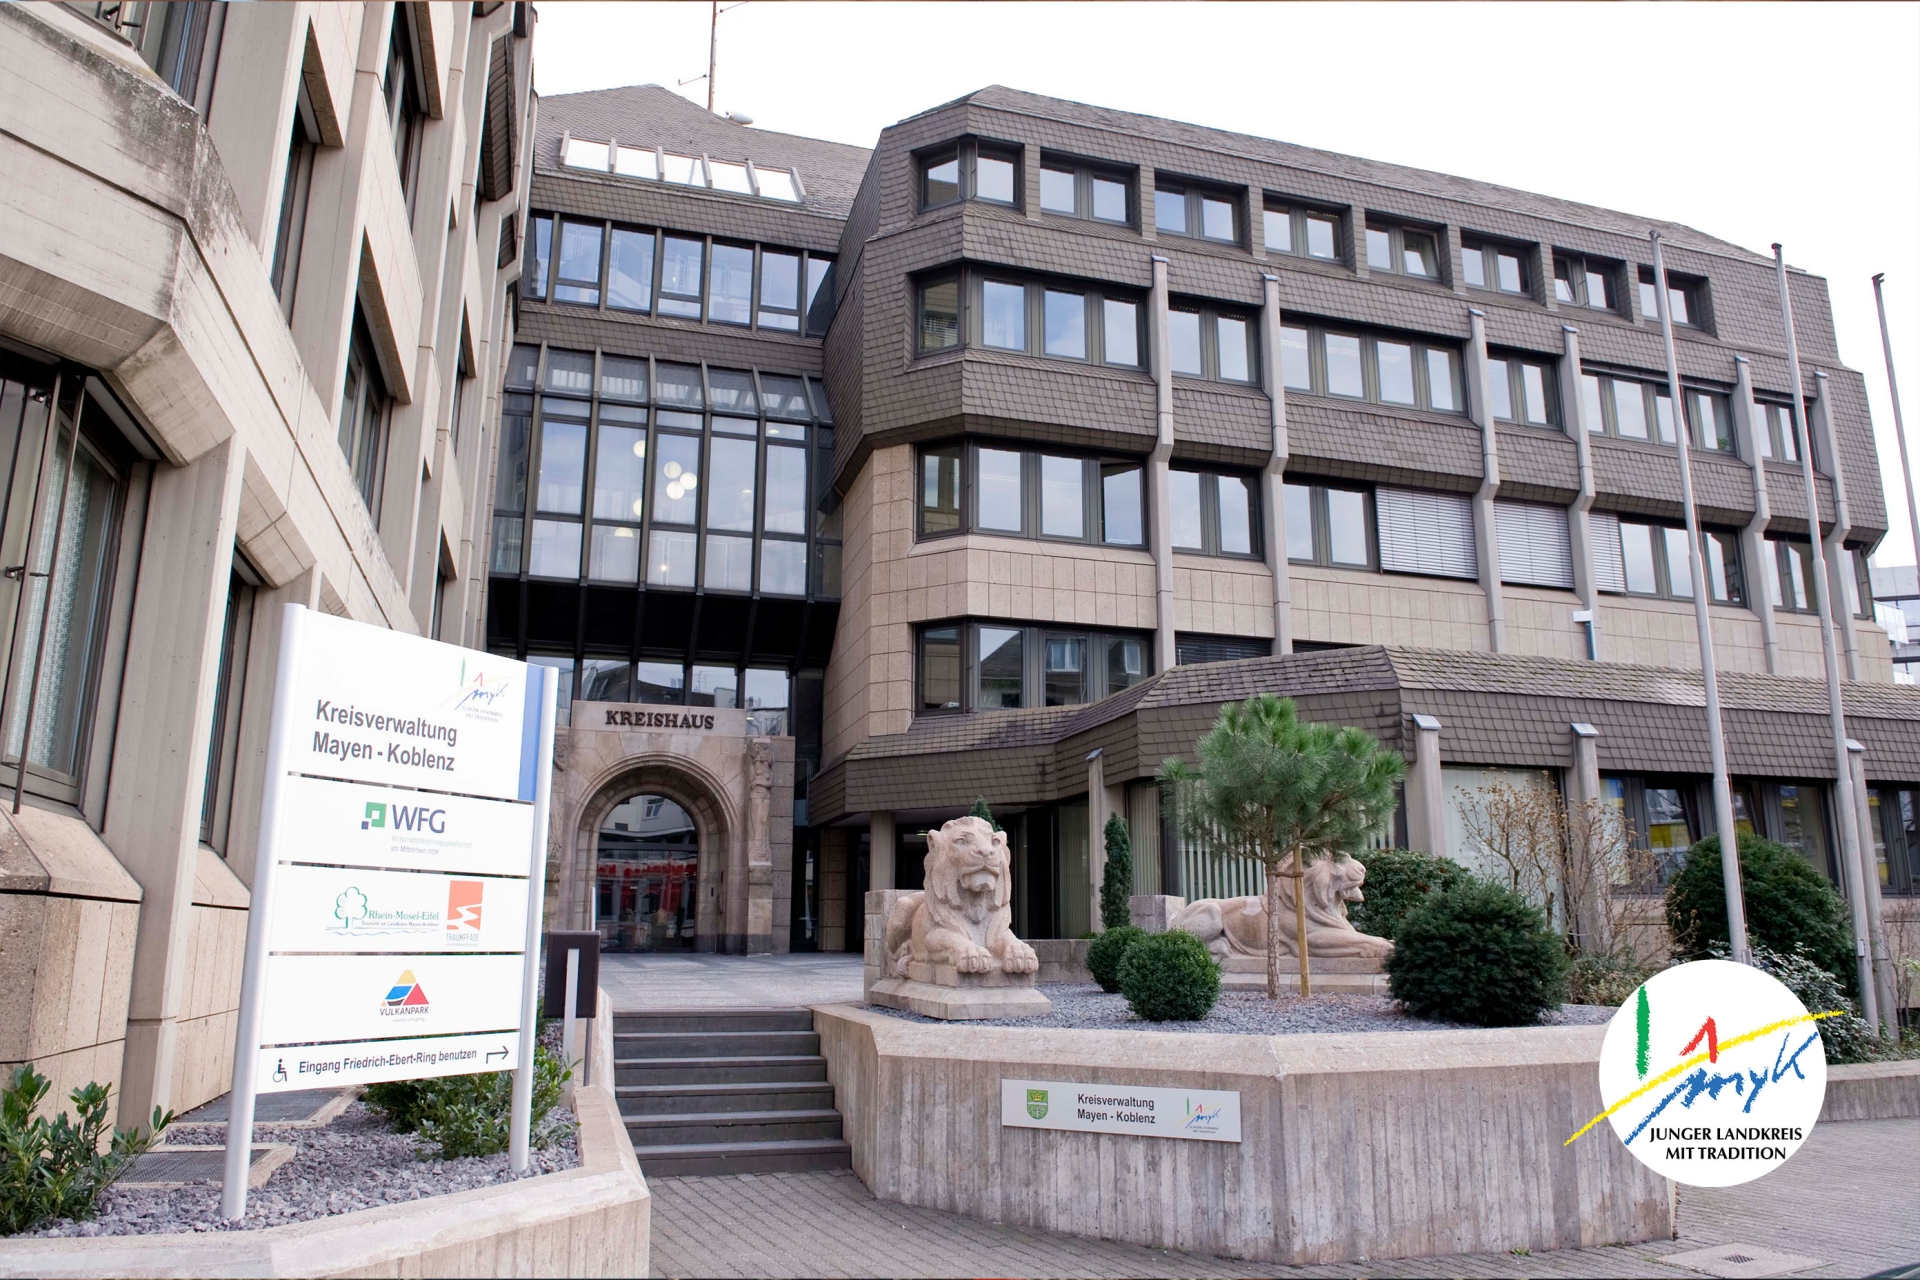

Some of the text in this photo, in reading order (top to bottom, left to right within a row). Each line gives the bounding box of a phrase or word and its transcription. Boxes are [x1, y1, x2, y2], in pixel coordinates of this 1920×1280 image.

[316, 699, 458, 746] Kreisverwaltung
[605, 710, 715, 729] KREISHAUS
[313, 731, 373, 761] Mayen
[387, 742, 455, 772] Koblenz
[392, 804, 447, 834] WFG
[368, 909, 440, 921] Rhein-Mosel-Eifel
[380, 1006, 429, 1016] VULKANPARK
[299, 1049, 477, 1074] Eingang Friedrich-Ebert-Ring benutzen
[1077, 1093, 1155, 1110] Kreisverwaltung
[1077, 1109, 1108, 1124] Mayen
[1116, 1111, 1156, 1124] Koblenz
